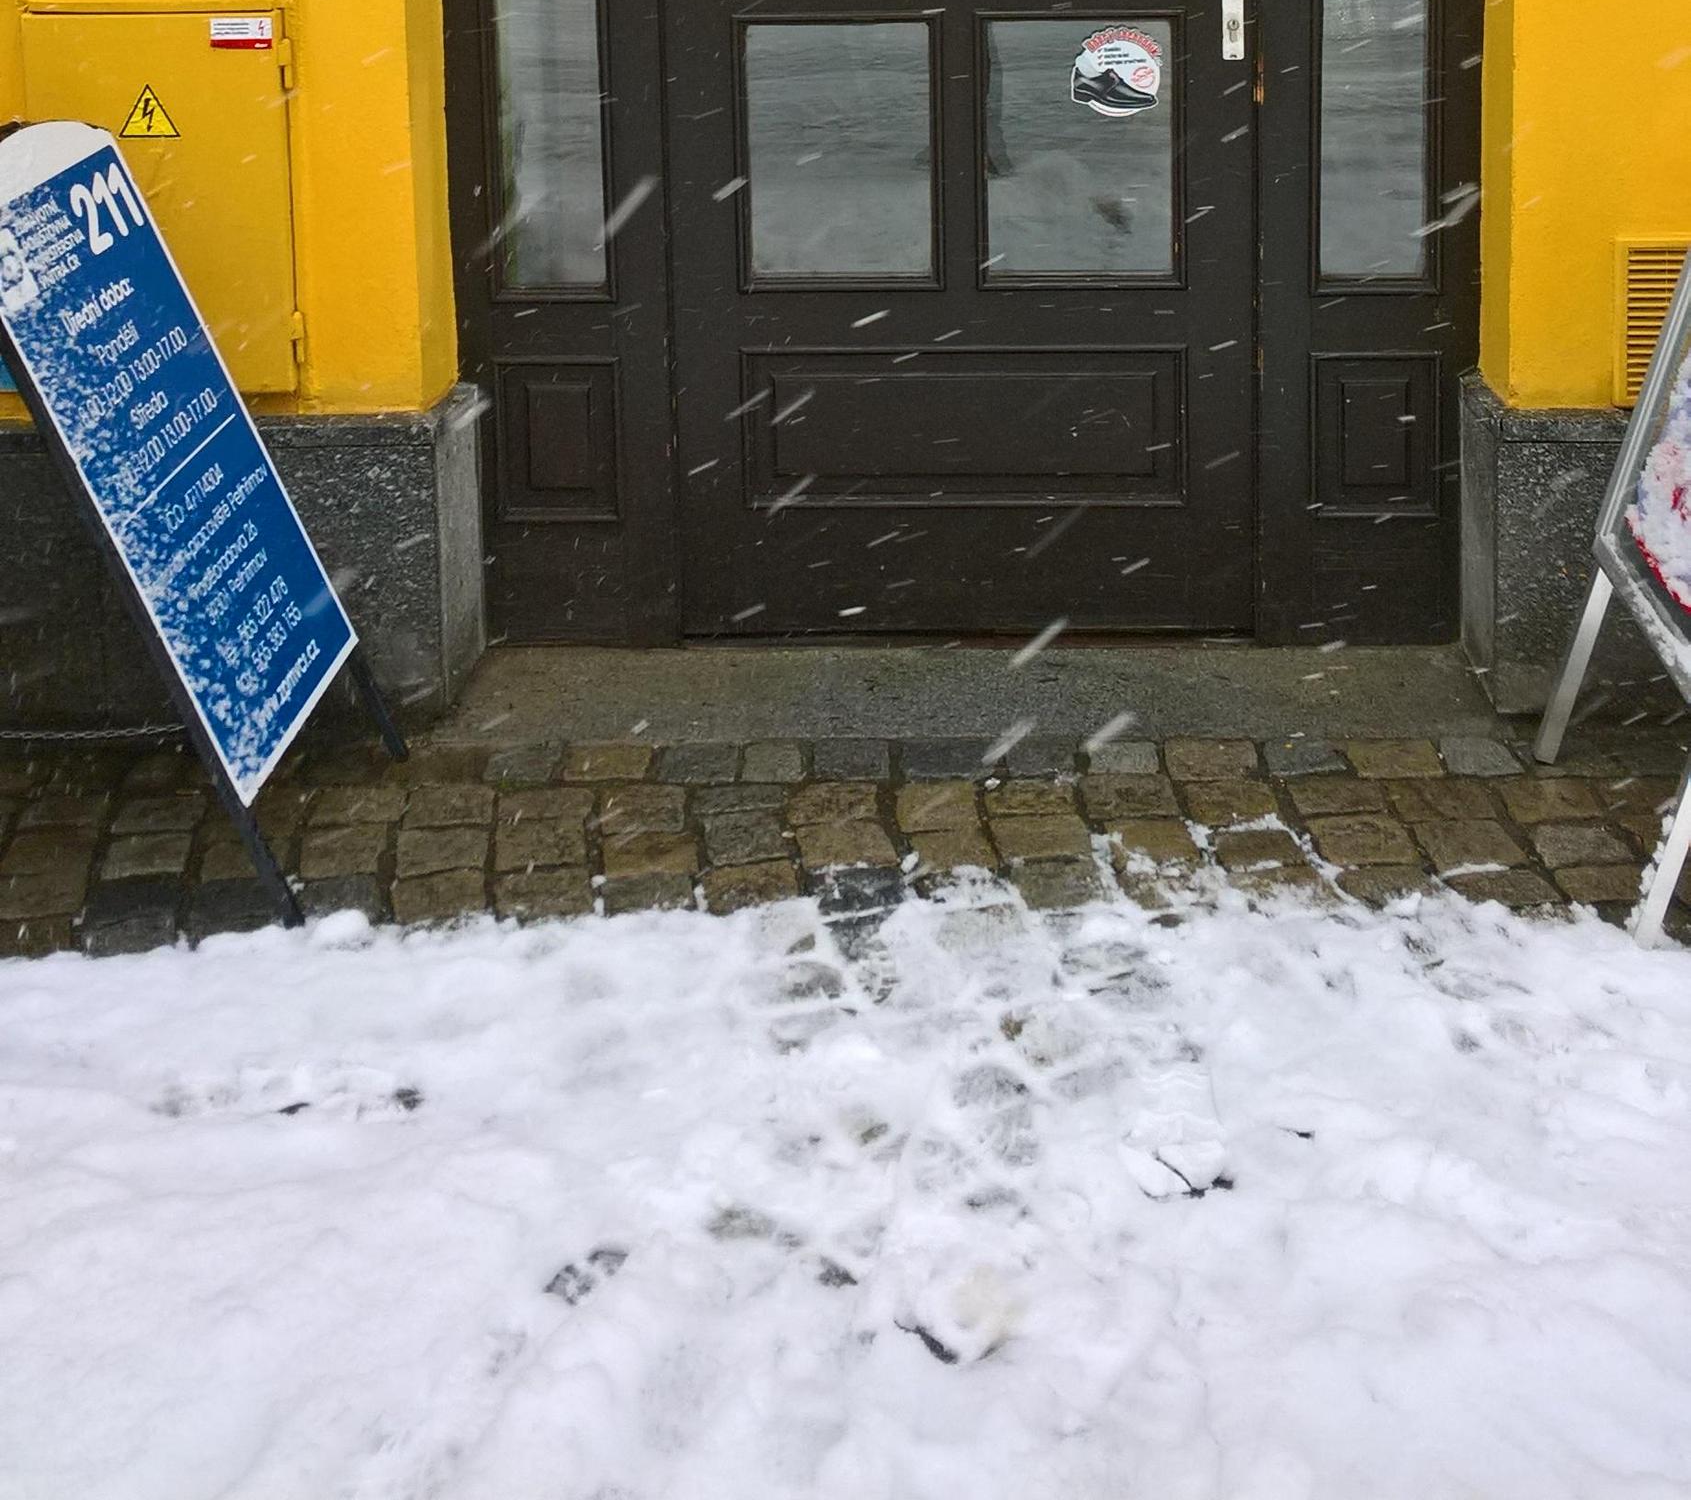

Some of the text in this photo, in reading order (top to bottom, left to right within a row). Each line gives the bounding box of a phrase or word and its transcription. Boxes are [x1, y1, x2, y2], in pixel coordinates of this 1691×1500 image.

[70, 164, 142, 253] 211
[99, 278, 133, 310] doba:
[95, 320, 138, 365] Pondělí
[130, 391, 167, 429] Středa
[226, 467, 267, 509] Pelhřimov
[227, 553, 266, 591] Pelhřimov
[253, 594, 273, 624] 322
[269, 575, 287, 603] 478
